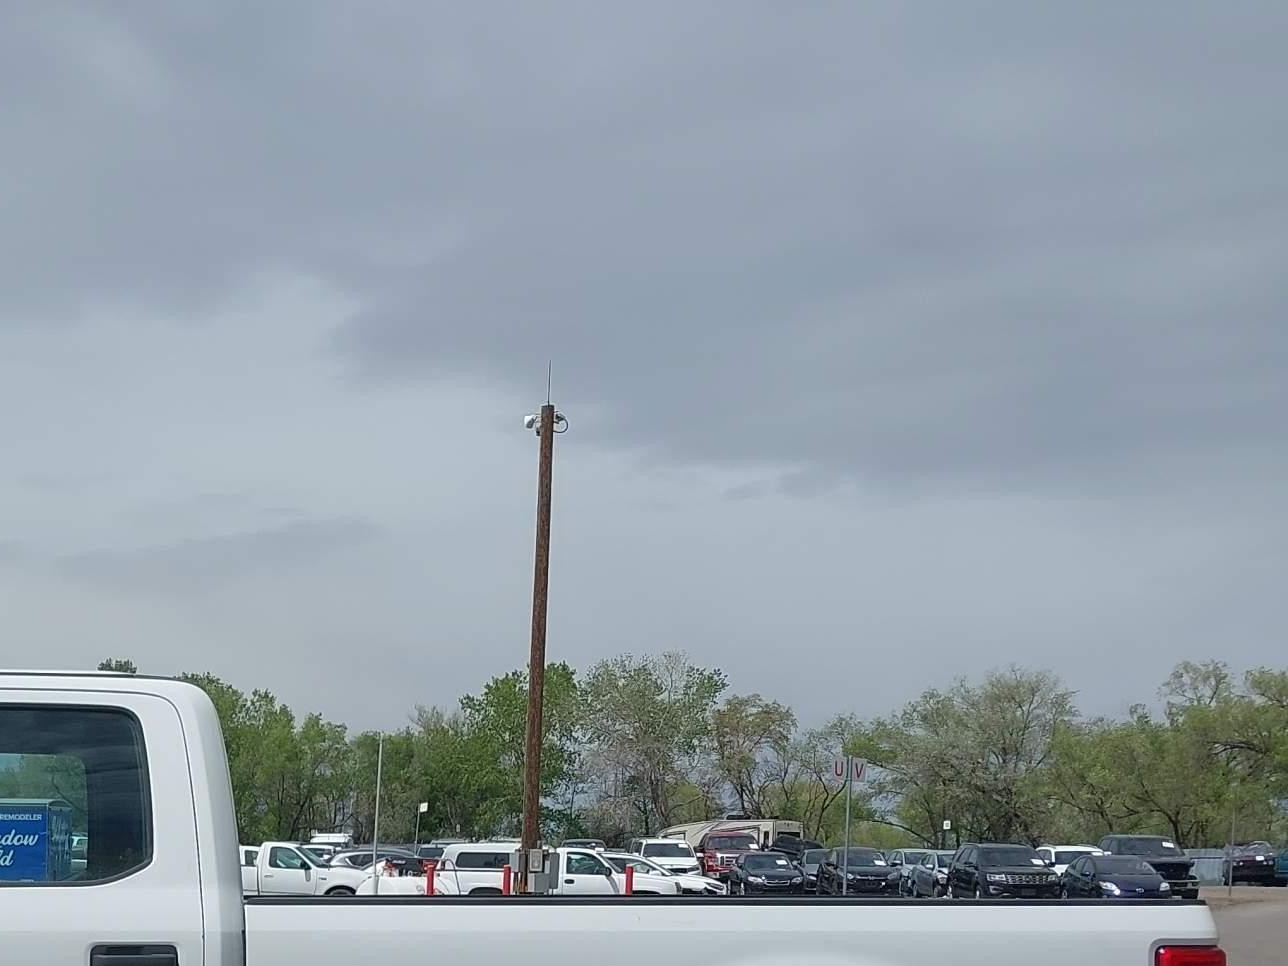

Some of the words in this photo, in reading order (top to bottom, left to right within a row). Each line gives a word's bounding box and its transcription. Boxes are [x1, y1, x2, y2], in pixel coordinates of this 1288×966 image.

[834, 760, 844, 777] U
[855, 762, 865, 778] V
[0, 813, 43, 821] REMODELER
